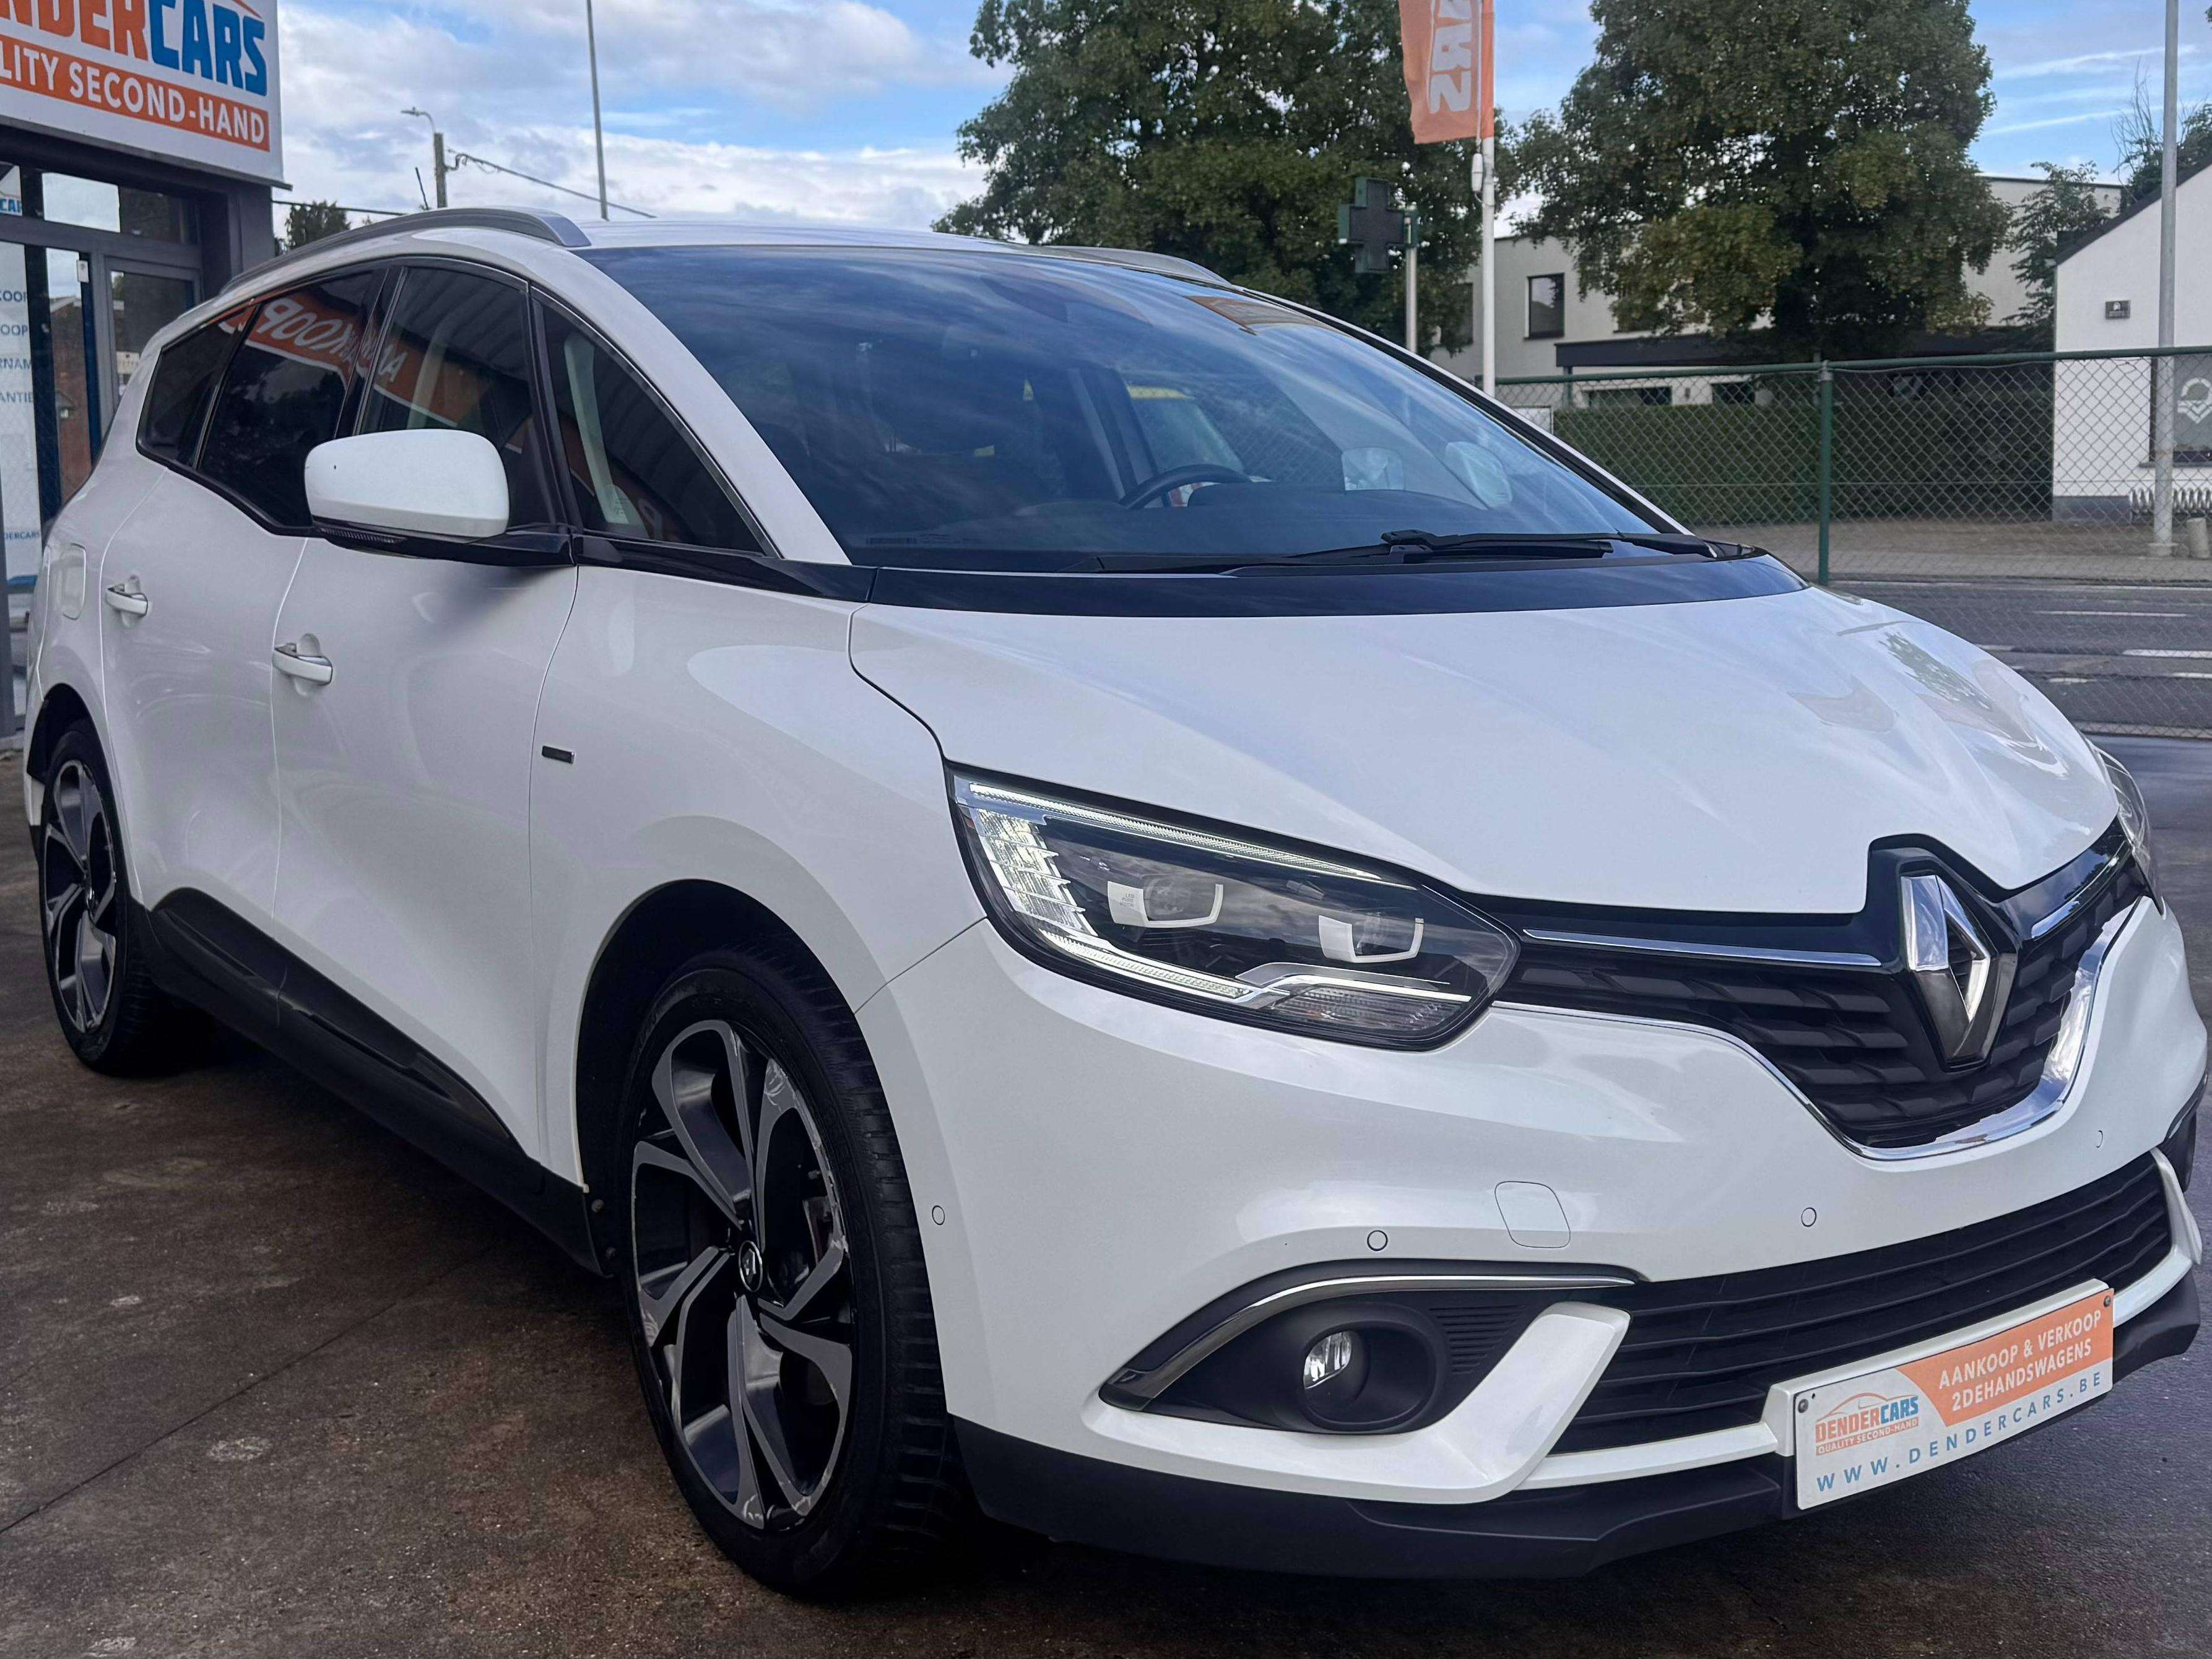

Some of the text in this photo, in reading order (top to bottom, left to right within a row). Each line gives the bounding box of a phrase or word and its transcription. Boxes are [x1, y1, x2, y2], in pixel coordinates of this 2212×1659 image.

[69, 61, 265, 144] SECOND-HAND
[1939, 1309, 2102, 1390] AANKOOP & VERKOOP
[1952, 1338, 2092, 1412] 2DEHANDSWAGENS
[1815, 1395, 1919, 1444] DENDERCARS
[1816, 1371, 2101, 1492] WWW.DENDERCARS.BE
[1818, 1418, 1919, 1455] QUALITY SECOND-HAND
